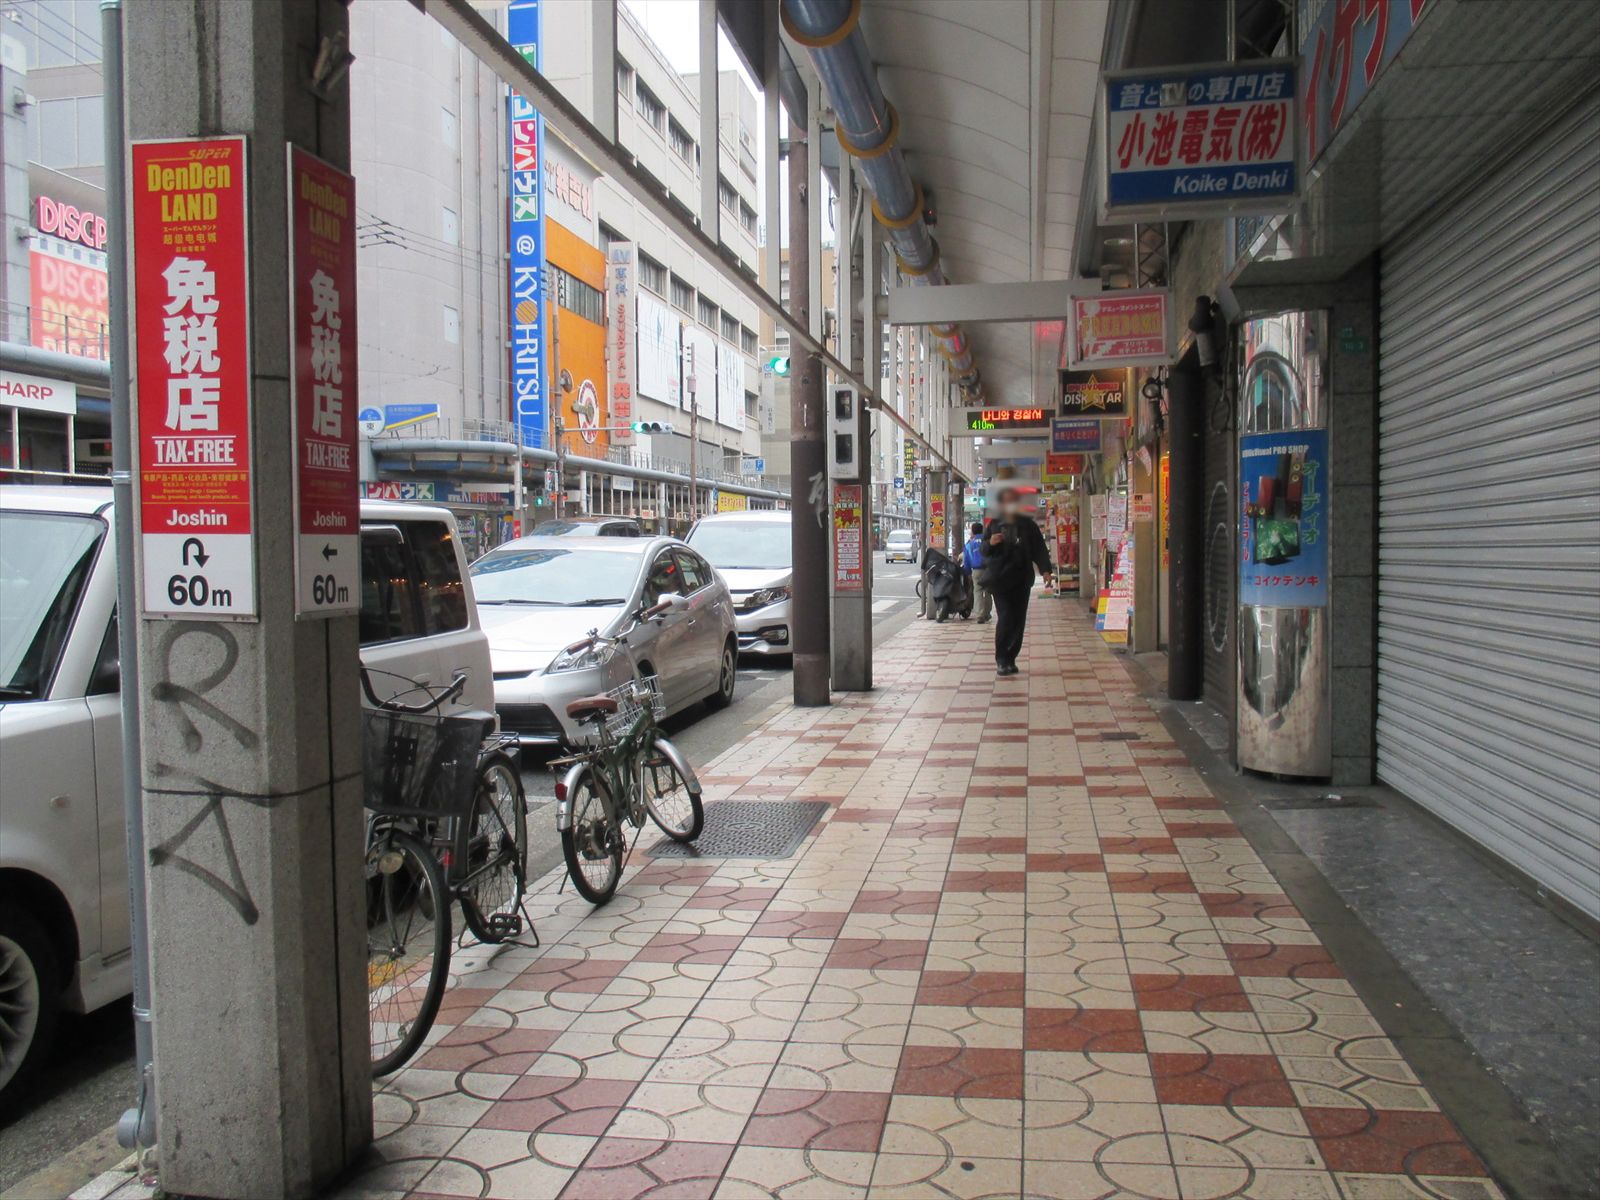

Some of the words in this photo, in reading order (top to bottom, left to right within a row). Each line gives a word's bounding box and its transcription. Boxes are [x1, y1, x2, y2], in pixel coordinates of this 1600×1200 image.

[189, 147, 231, 160] SUPER
[147, 162, 231, 192] DenDen
[1173, 174, 1228, 194] Koike
[1232, 169, 1288, 191] Denki
[161, 192, 218, 222] LAND
[161, 256, 221, 432] 免税店
[310, 269, 342, 438] 免税店
[1064, 393, 1088, 405] DISK
[1094, 392, 1122, 404] STAR
[971, 420, 995, 430] 410m
[154, 439, 234, 463] TAX-FREE
[306, 442, 350, 468] TAX-FREE
[1273, 445, 1287, 455] PRO
[1288, 444, 1309, 454] SHOP
[1303, 459, 1320, 545] オーディオ
[166, 509, 228, 527] Joshin
[312, 511, 347, 527] Joshin
